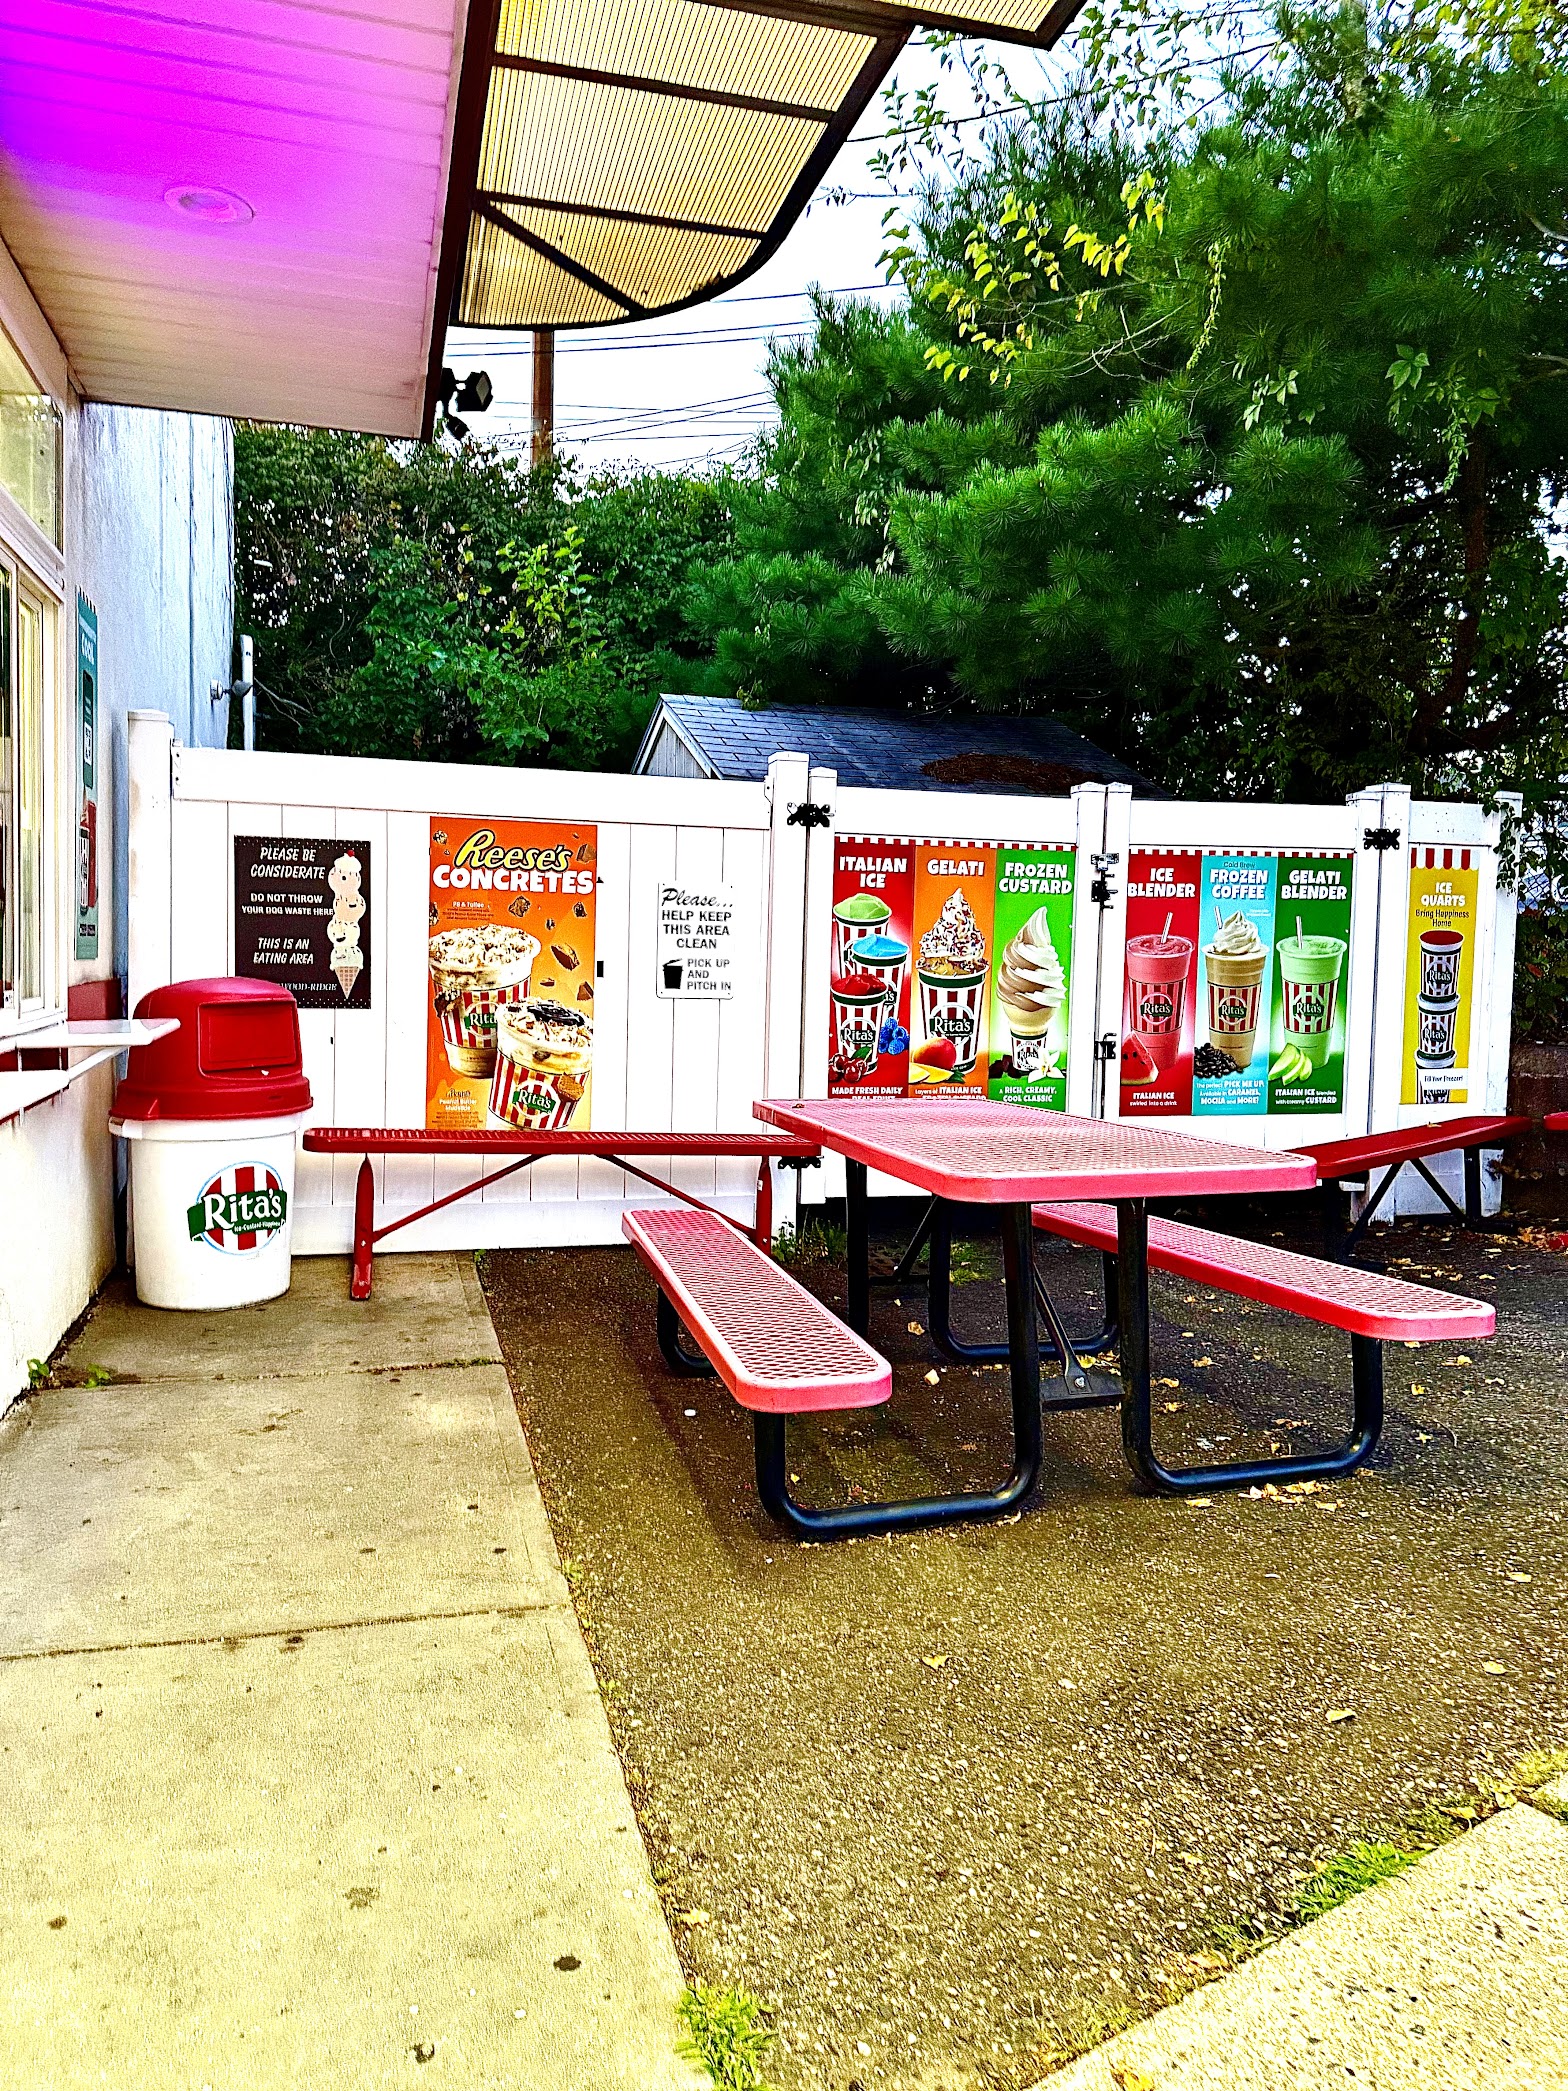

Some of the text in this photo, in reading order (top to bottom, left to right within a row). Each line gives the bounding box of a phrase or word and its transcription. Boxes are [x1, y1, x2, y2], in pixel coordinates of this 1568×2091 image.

[260, 847, 316, 862] PLEASE BE
[454, 829, 572, 872] Reese's
[839, 857, 907, 873] ITALIAN
[927, 859, 985, 876] GELATI
[1005, 862, 1067, 879] FROZEN
[251, 864, 325, 880] CONSIDERATE
[1150, 868, 1174, 882] ICE
[1210, 869, 1268, 884] FROZEN
[1289, 870, 1341, 885] GELATI
[433, 865, 594, 895] CONCRETES
[859, 874, 885, 888] ICE
[999, 879, 1072, 894] CUSTARD
[1128, 883, 1195, 898] BLENDER
[1212, 884, 1265, 899] COFFEE
[1281, 885, 1347, 900] BLENDER
[1435, 882, 1453, 894] ICE
[251, 893, 323, 904] DO NOT THROW
[1421, 894, 1466, 907] QUARTS
[242, 905, 334, 916] YOUR DOG WASTE HERE
[662, 910, 732, 922] HELP KEEP
[1415, 909, 1470, 919] Bring Happiness
[1432, 919, 1452, 927] Home
[663, 924, 730, 936] THIS AREA
[258, 938, 310, 950] THIS IS AN
[676, 938, 717, 949] CLEAN
[253, 952, 314, 965] EATING AREA
[687, 958, 730, 968] PICK UP
[687, 970, 710, 979] AND
[687, 981, 731, 990] PITCH IN
[1144, 1002, 1171, 1015] Rita's
[1221, 1004, 1245, 1015] Rita's
[934, 1016, 971, 1034] Rita's
[844, 1029, 874, 1041] Rita's
[1223, 1080, 1240, 1088] PICK
[1242, 1080, 1253, 1088] ME
[831, 1086, 903, 1095] MADE FRESH DAILY
[939, 1086, 969, 1095] ITALIAN
[970, 1086, 982, 1095] ICE
[1133, 1092, 1175, 1100] ITALIAN ICE
[1275, 1088, 1303, 1096] ITALIAN
[1304, 1088, 1316, 1096] ICE
[519, 1089, 552, 1109] Rita's
[1023, 1095, 1053, 1103] CLASSIC
[1200, 1097, 1226, 1105] MOCHA
[1305, 1096, 1337, 1104] CUSTARD
[203, 1188, 282, 1230] Rita's
